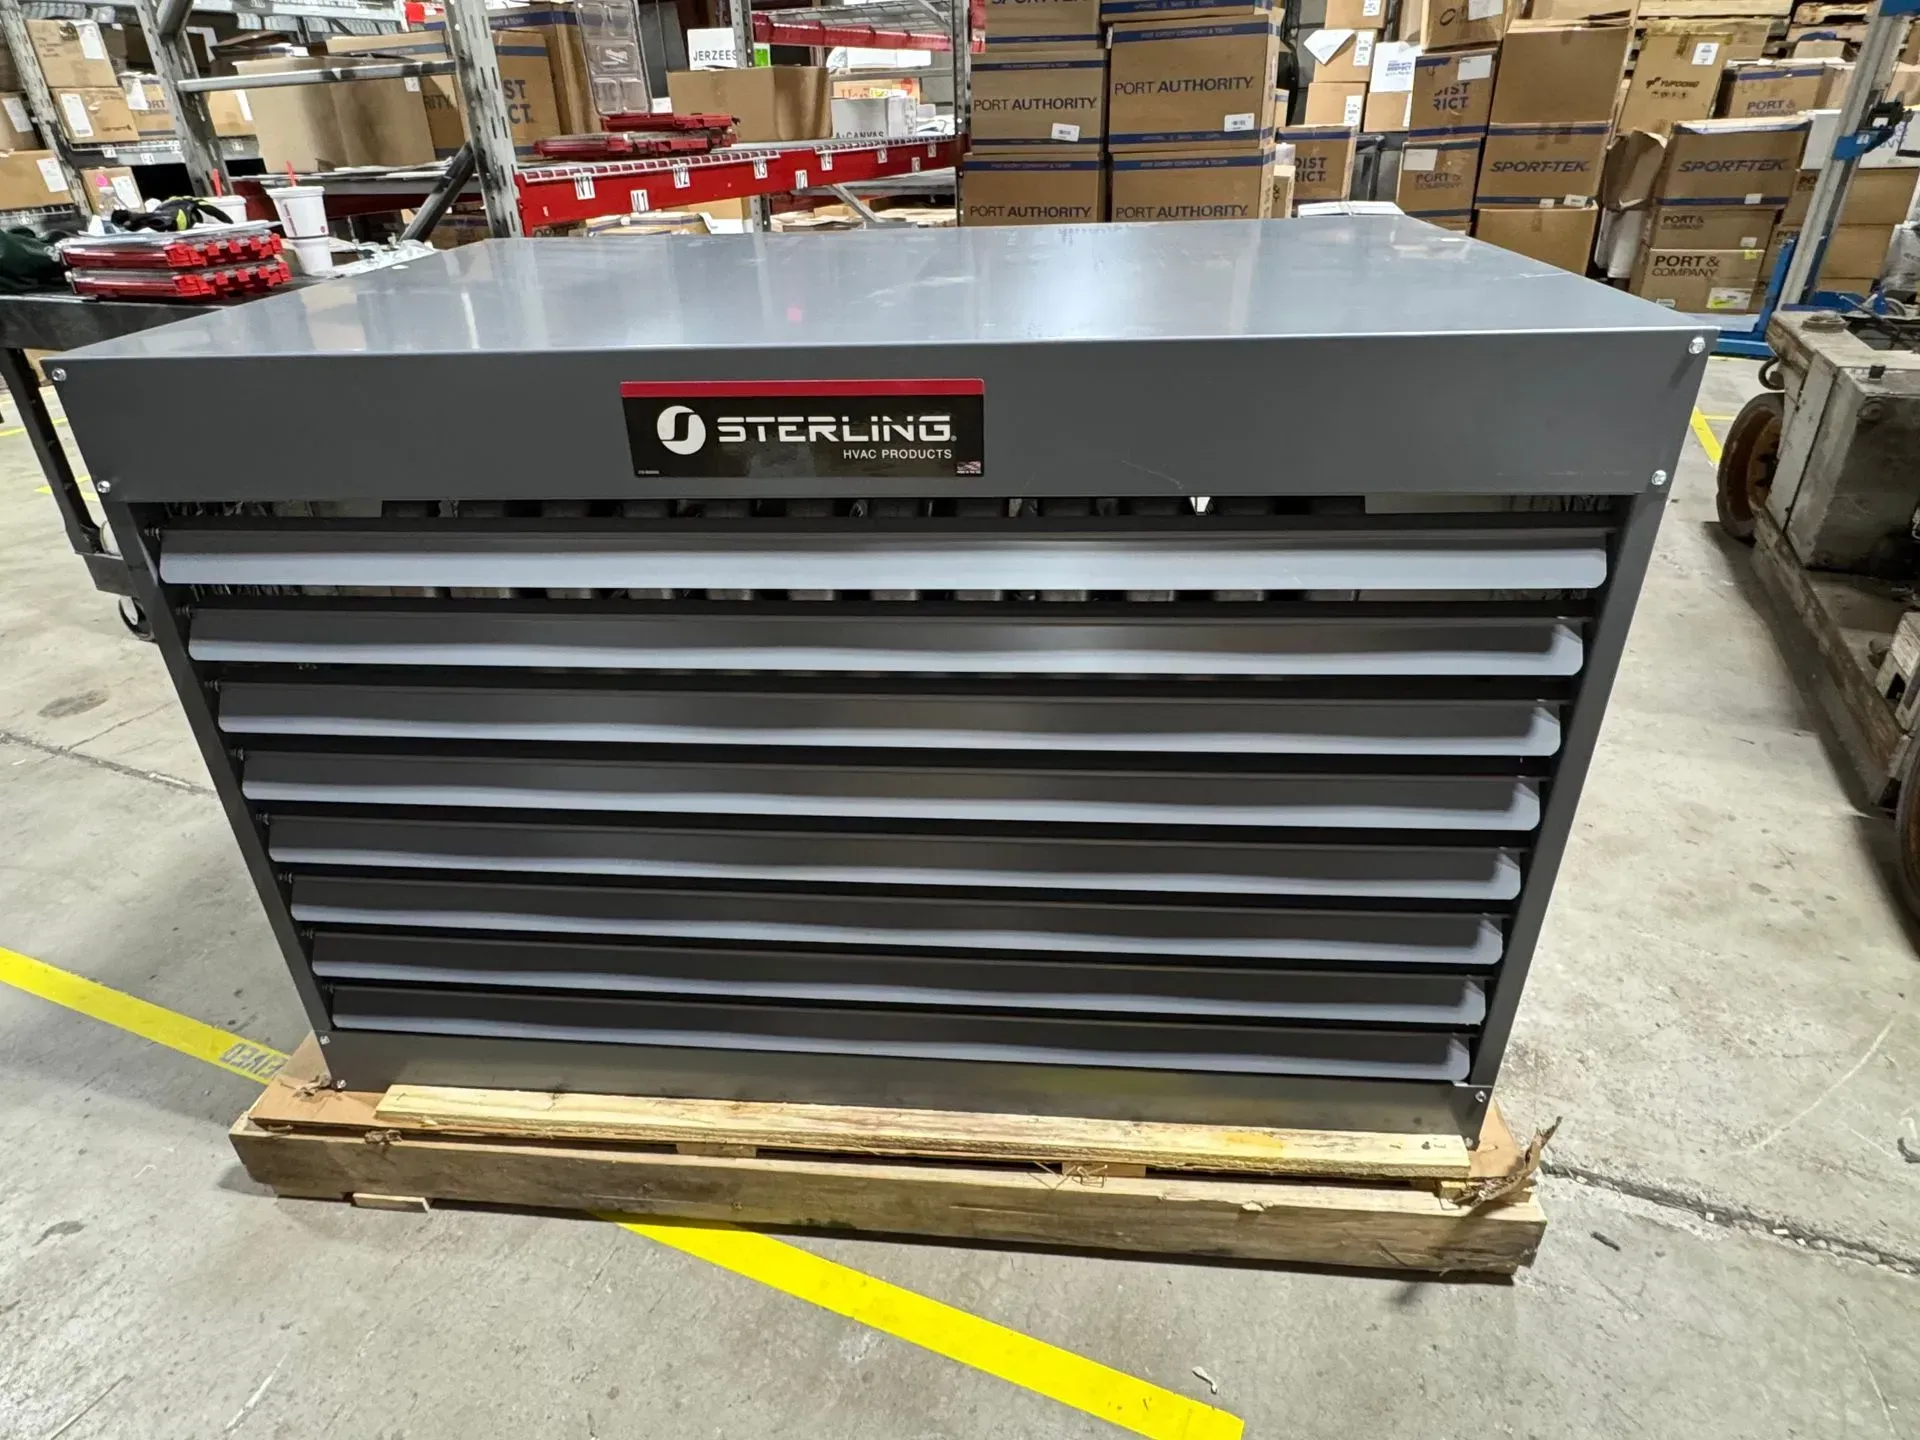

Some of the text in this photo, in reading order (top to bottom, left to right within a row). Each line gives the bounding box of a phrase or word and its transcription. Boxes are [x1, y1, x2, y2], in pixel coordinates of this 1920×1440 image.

[693, 50, 737, 62] JERZEES
[1114, 76, 1254, 96] PORT AUTHORITY
[974, 97, 1097, 111] PORT AUTHORITY
[970, 206, 1092, 218] PORT AUTHORITY
[1116, 205, 1249, 218] PORT AUTHORITY
[1654, 256, 1720, 267] PORT &
[1652, 268, 1718, 277] COMPANY
[717, 415, 951, 442] STERLING
[843, 448, 952, 459] HVAC PRODUCTS
